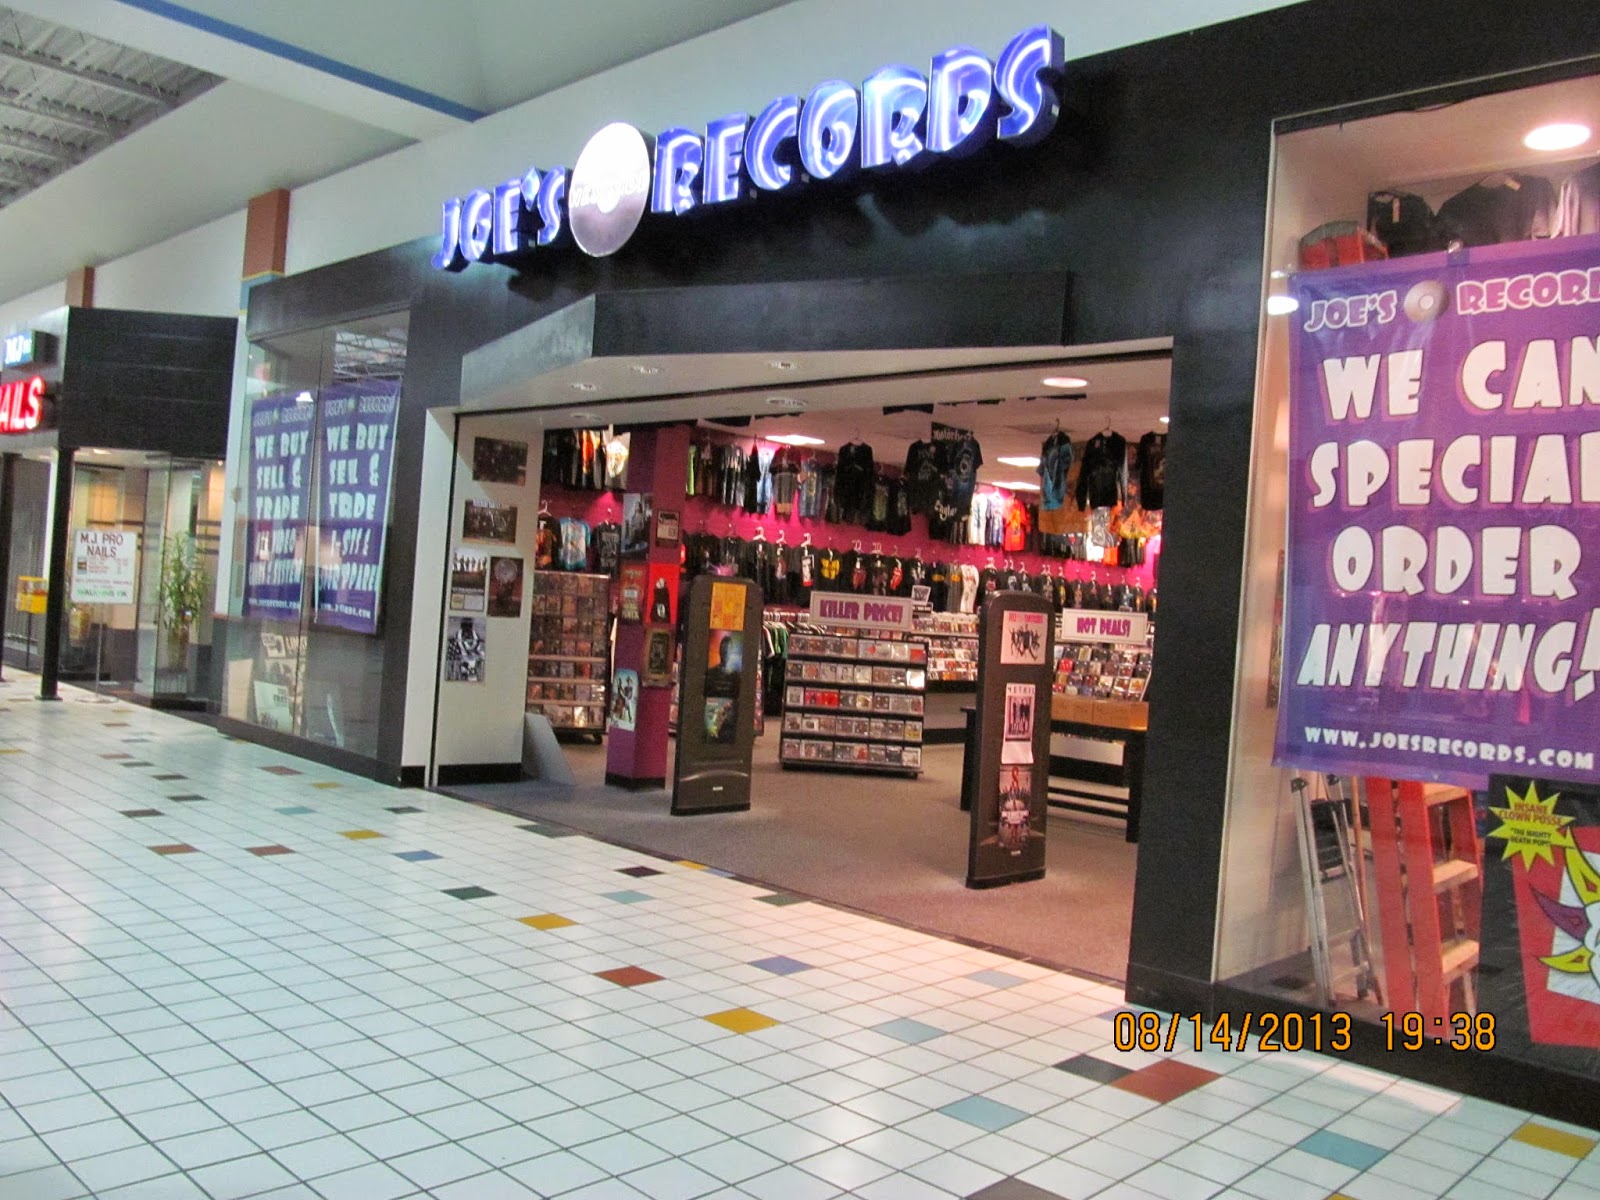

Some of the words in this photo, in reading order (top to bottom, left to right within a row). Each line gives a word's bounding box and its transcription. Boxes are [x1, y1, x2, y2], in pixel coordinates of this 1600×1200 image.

[432, 165, 567, 269] JOE'S
[651, 24, 1064, 216] RECORDS
[1304, 290, 1398, 333] JOE'S
[1322, 350, 1423, 420] WE
[1462, 335, 1600, 408] CAN
[0, 376, 44, 430] AILS
[255, 434, 275, 459] WE
[326, 424, 350, 453] WE
[356, 422, 389, 451] BUY
[256, 494, 300, 520] TRADE
[87, 545, 117, 558] NAILS
[1333, 524, 1582, 600] ORDER
[1076, 617, 1097, 634] HOT
[1297, 607, 1600, 702] ANYTHING!
[1305, 727, 1594, 770] WWW.JOESRECORDS.COM
